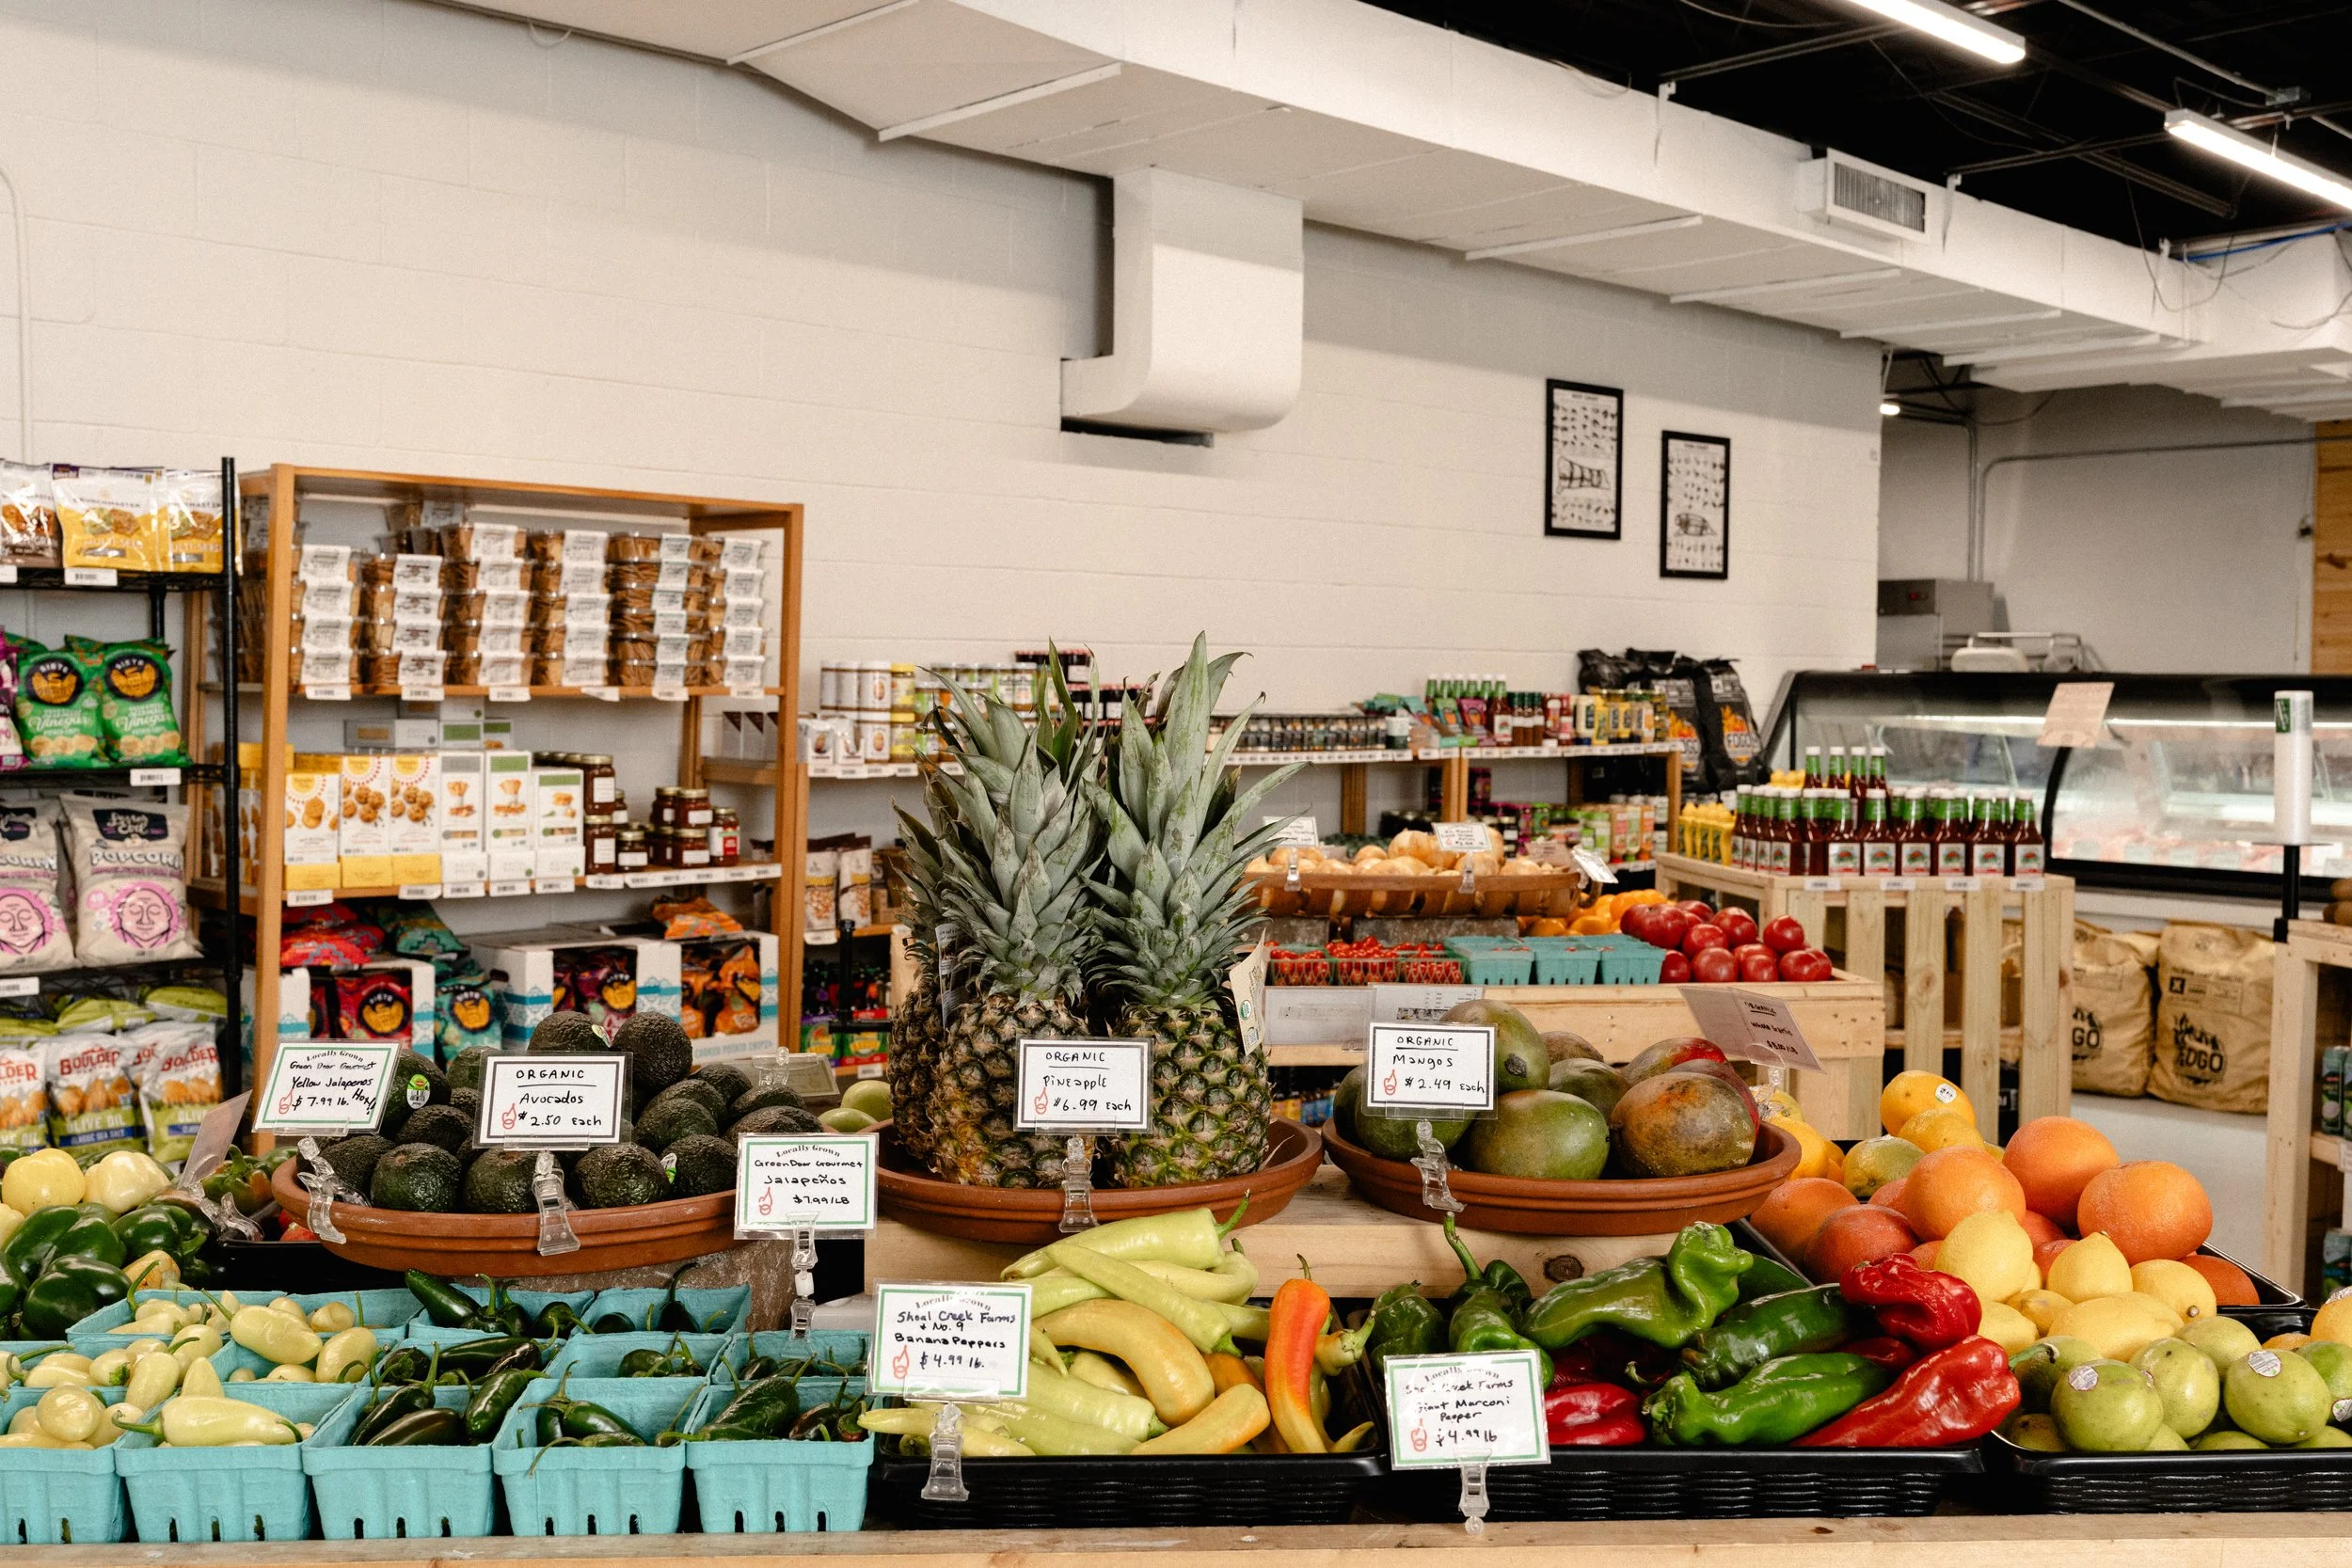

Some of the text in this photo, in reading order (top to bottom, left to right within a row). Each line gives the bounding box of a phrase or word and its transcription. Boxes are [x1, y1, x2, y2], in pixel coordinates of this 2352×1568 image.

[1397, 1036, 1454, 1046] ORGANIC
[2072, 1026, 2100, 1050] GO
[307, 1051, 364, 1062] Locally Grown
[1045, 1052, 1105, 1062] ORGANIC
[1392, 1054, 1454, 1069] Mangos
[0, 1062, 38, 1082] LDER
[516, 1069, 585, 1080] ORGANIC
[292, 1076, 321, 1089] Yellow
[519, 1090, 583, 1104] Avocados
[775, 1145, 841, 1158] Locally Grown
[815, 1160, 863, 1168] Gourmet
[764, 1174, 847, 1187] Jalapeños
[897, 1310, 1016, 1323] Shoal Creek Farms
[1455, 1396, 1510, 1409] Marconi
[1440, 1411, 1483, 1423] Pepper
